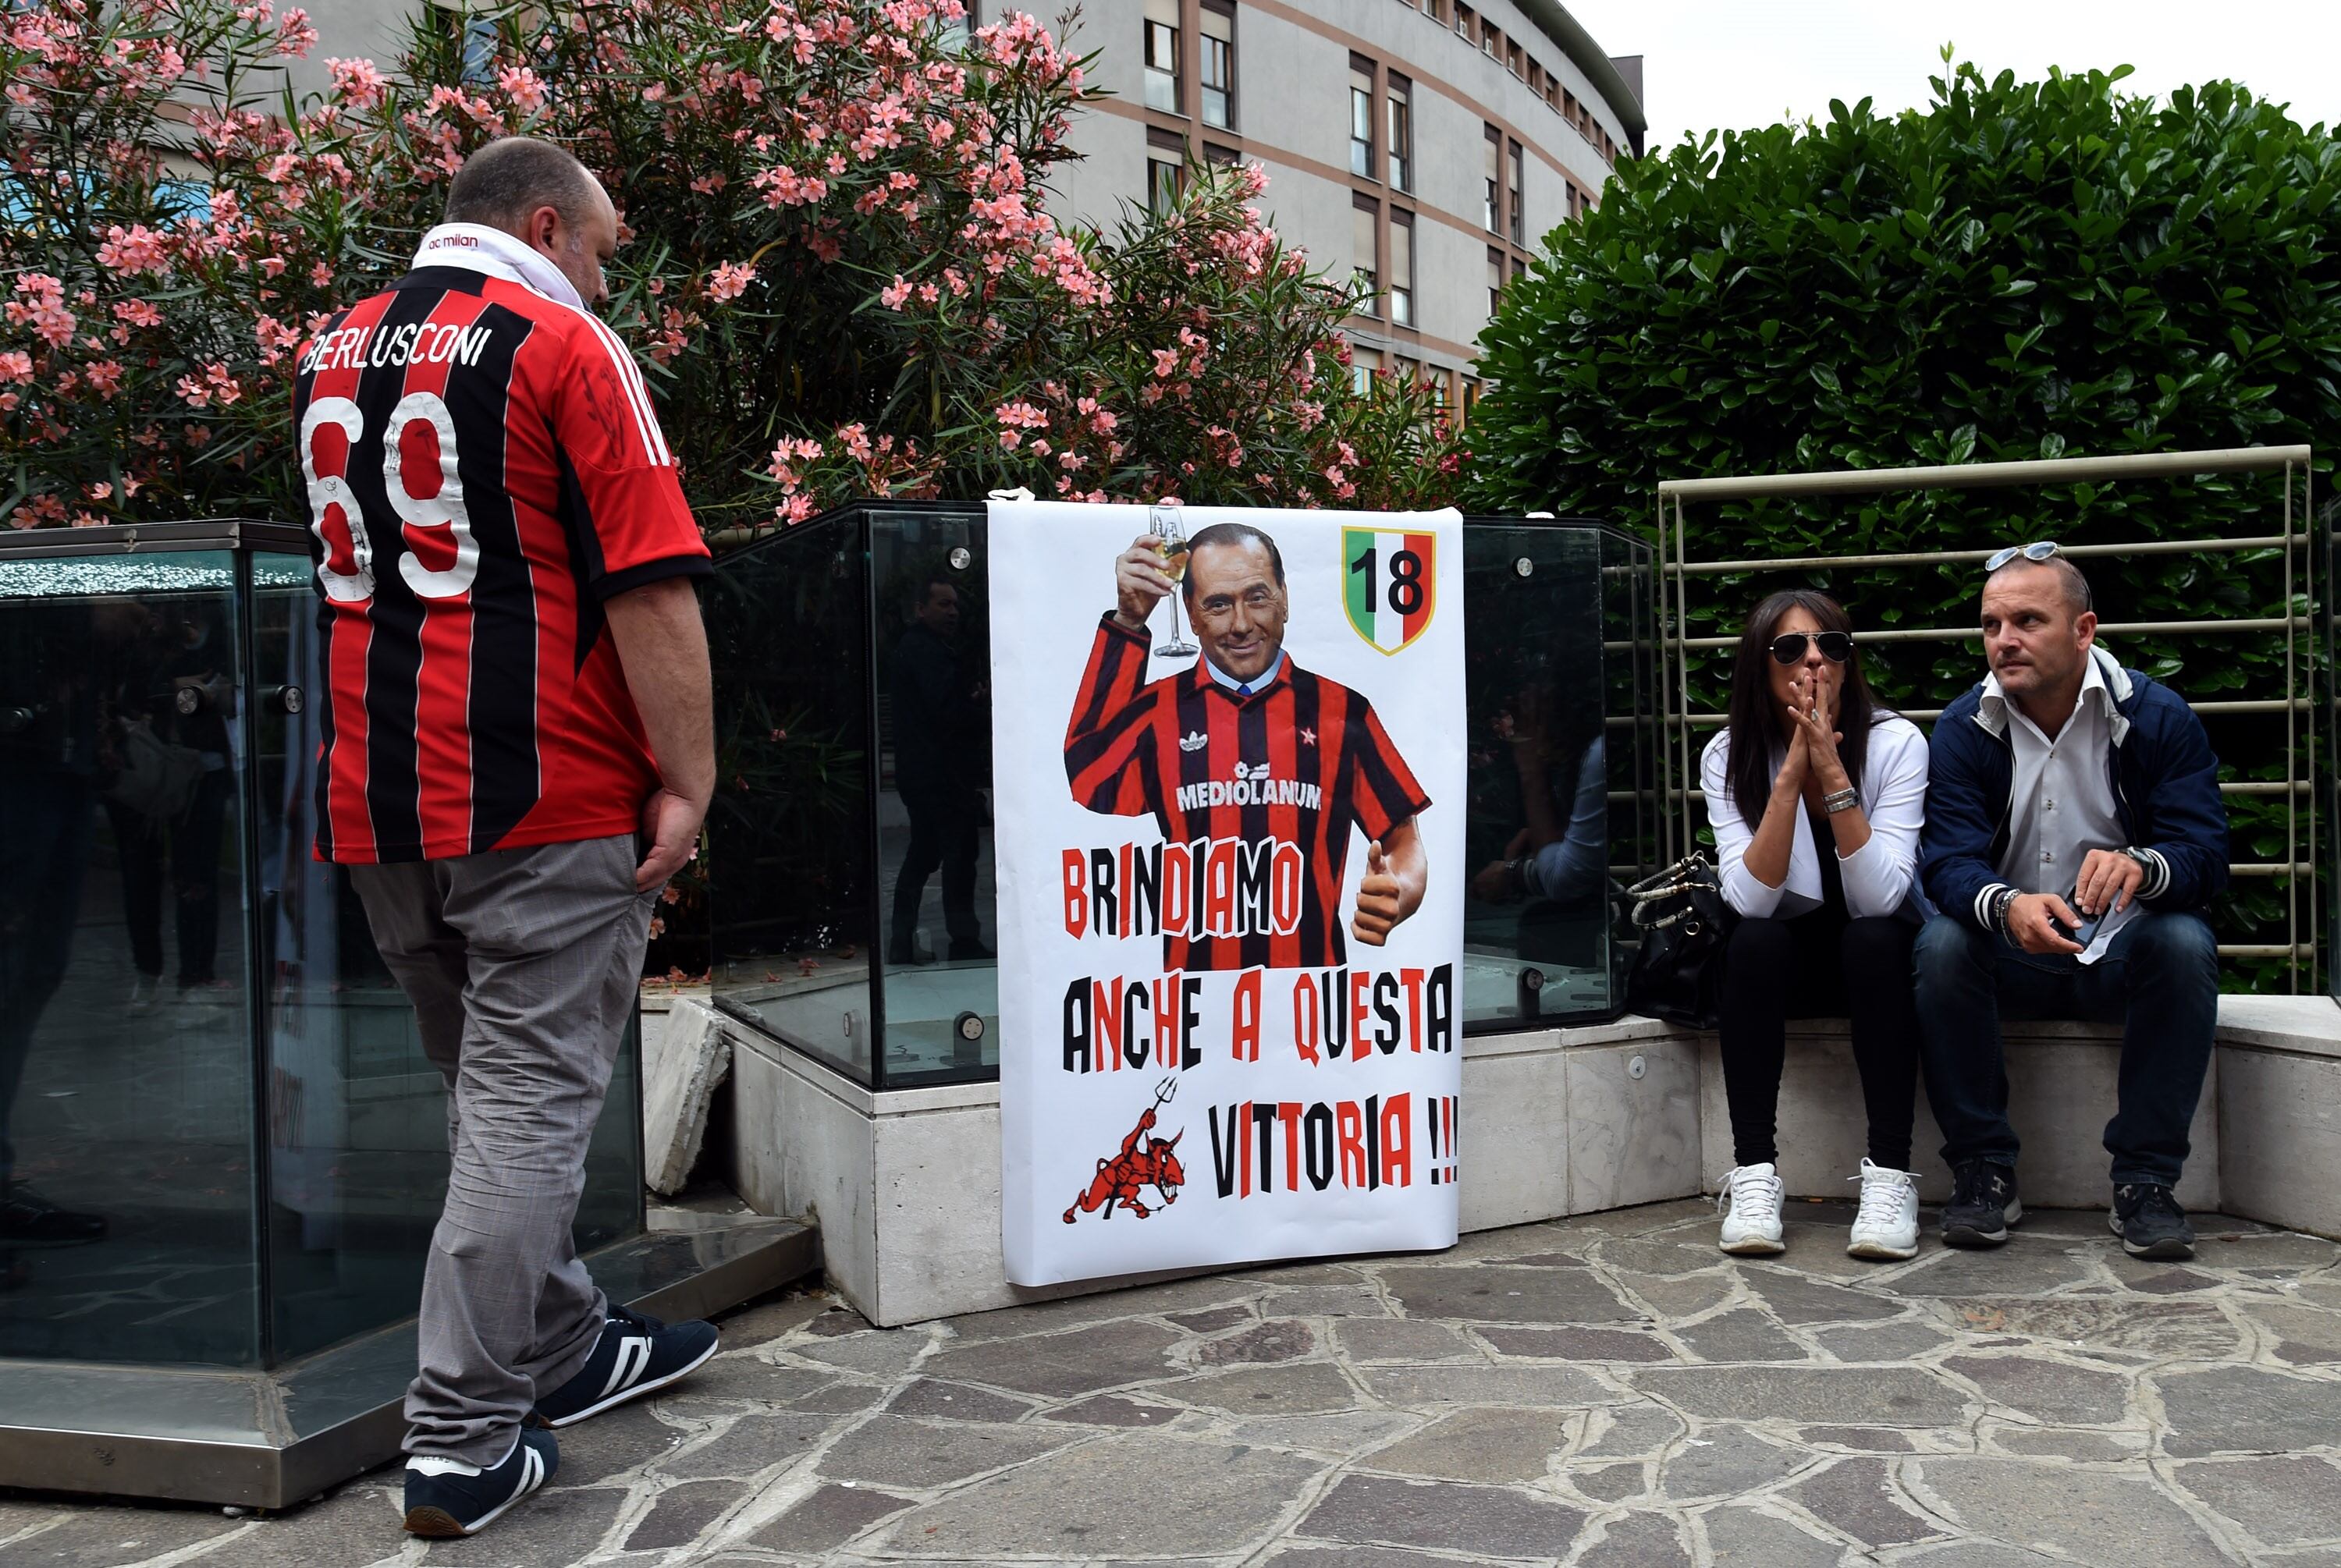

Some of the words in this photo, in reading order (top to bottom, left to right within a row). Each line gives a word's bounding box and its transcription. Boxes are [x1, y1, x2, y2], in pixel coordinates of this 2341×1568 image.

[428, 239, 441, 250] ac
[443, 233, 478, 247] milan
[300, 323, 492, 375] BERLUSCONI
[300, 392, 480, 602] 69
[1352, 548, 1423, 615] 18
[1176, 779, 1322, 812] MEDIOLANUM
[1062, 841, 1301, 940] BRINDIAMO
[1064, 972, 1202, 1073] ANCHE
[1232, 970, 1262, 1062] A
[1294, 963, 1452, 1068] QUESTA
[1209, 1092, 1411, 1199] VITTORIA
